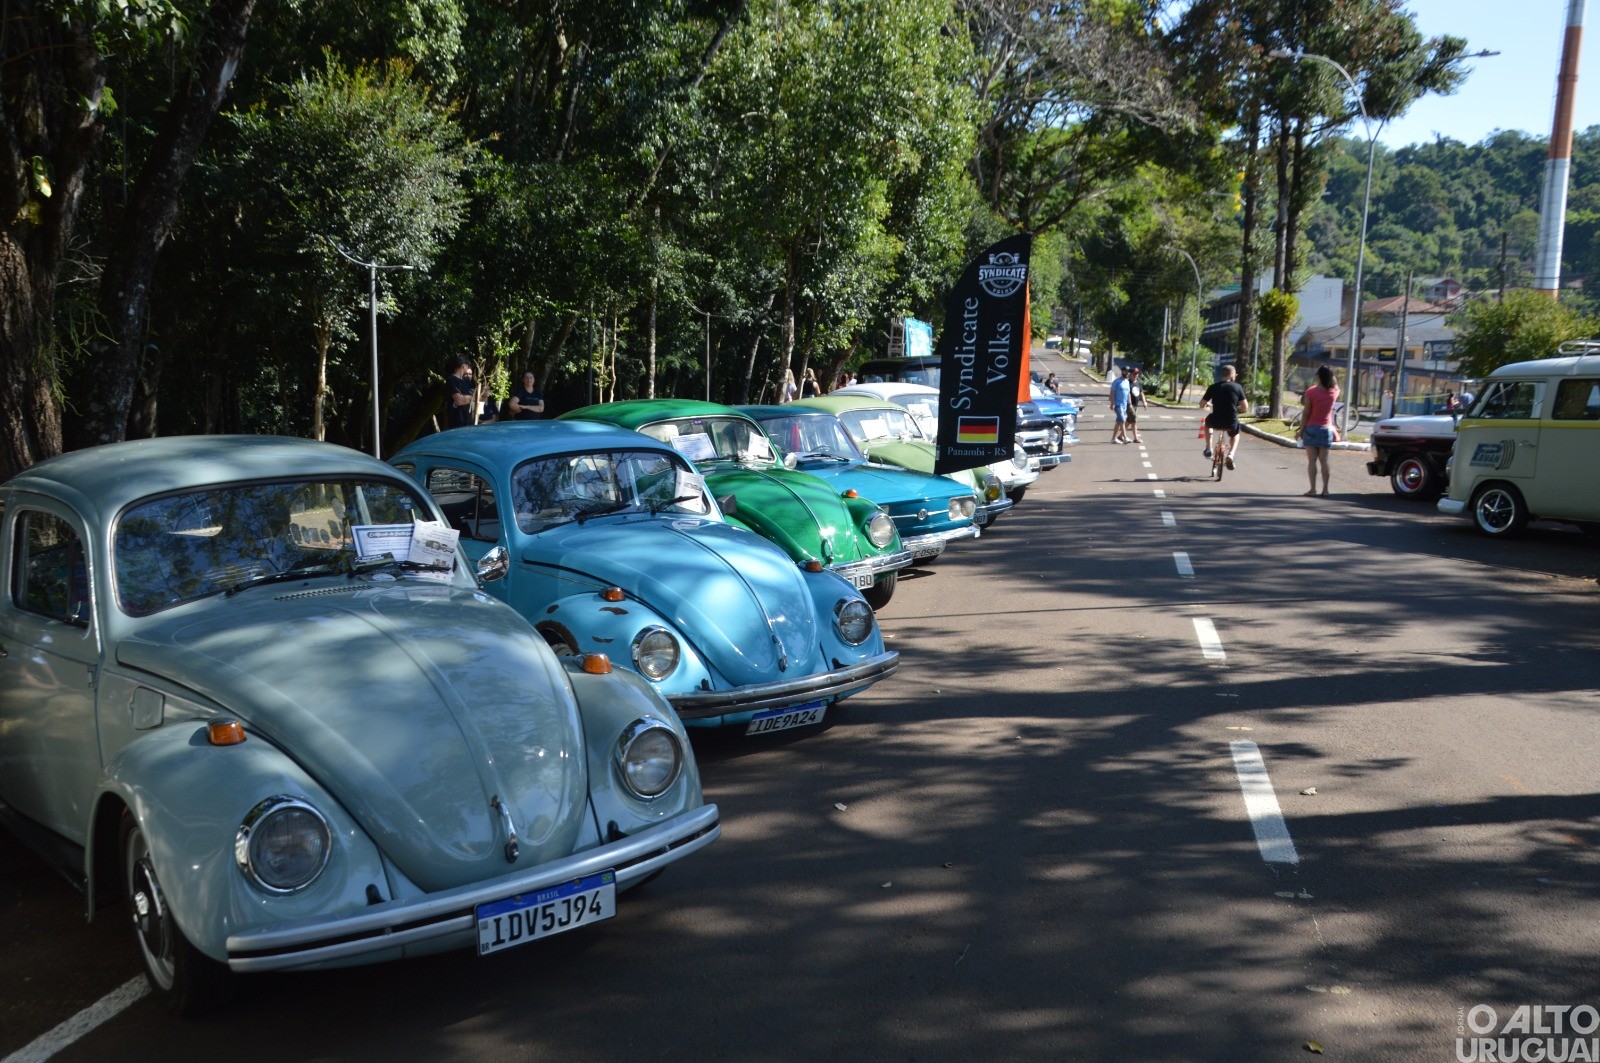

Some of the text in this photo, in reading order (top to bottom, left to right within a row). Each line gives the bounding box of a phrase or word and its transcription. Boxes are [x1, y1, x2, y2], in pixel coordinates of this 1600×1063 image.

[979, 267, 1026, 280] SYNDICATE
[950, 297, 979, 410] Syndicate
[986, 322, 1011, 386] Volks
[947, 446, 985, 456] Panambi
[994, 446, 1007, 455] RS
[754, 710, 817, 732] IDE9A24
[537, 890, 560, 902] BRASIL
[491, 890, 602, 947] IDV5J94
[481, 942, 490, 952] BR
